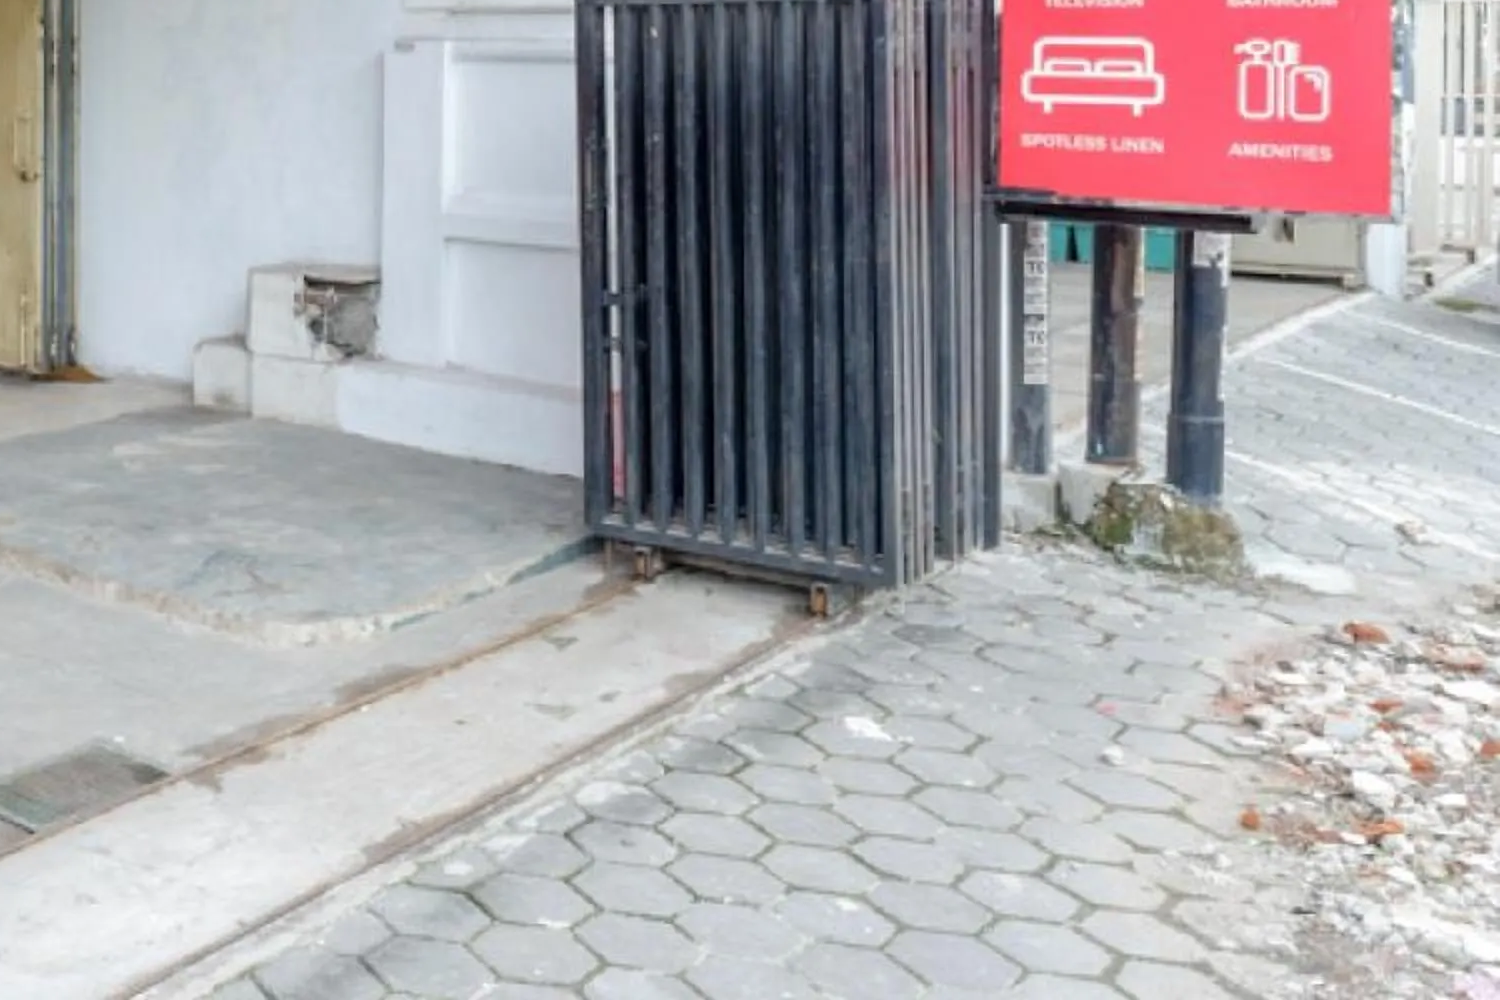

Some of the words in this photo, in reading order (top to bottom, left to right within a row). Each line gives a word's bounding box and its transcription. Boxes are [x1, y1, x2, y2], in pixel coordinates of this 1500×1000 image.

[1021, 133, 1107, 152] SPOTLESS
[1111, 137, 1164, 154] LINEN
[1228, 142, 1332, 162] AMENITIES
